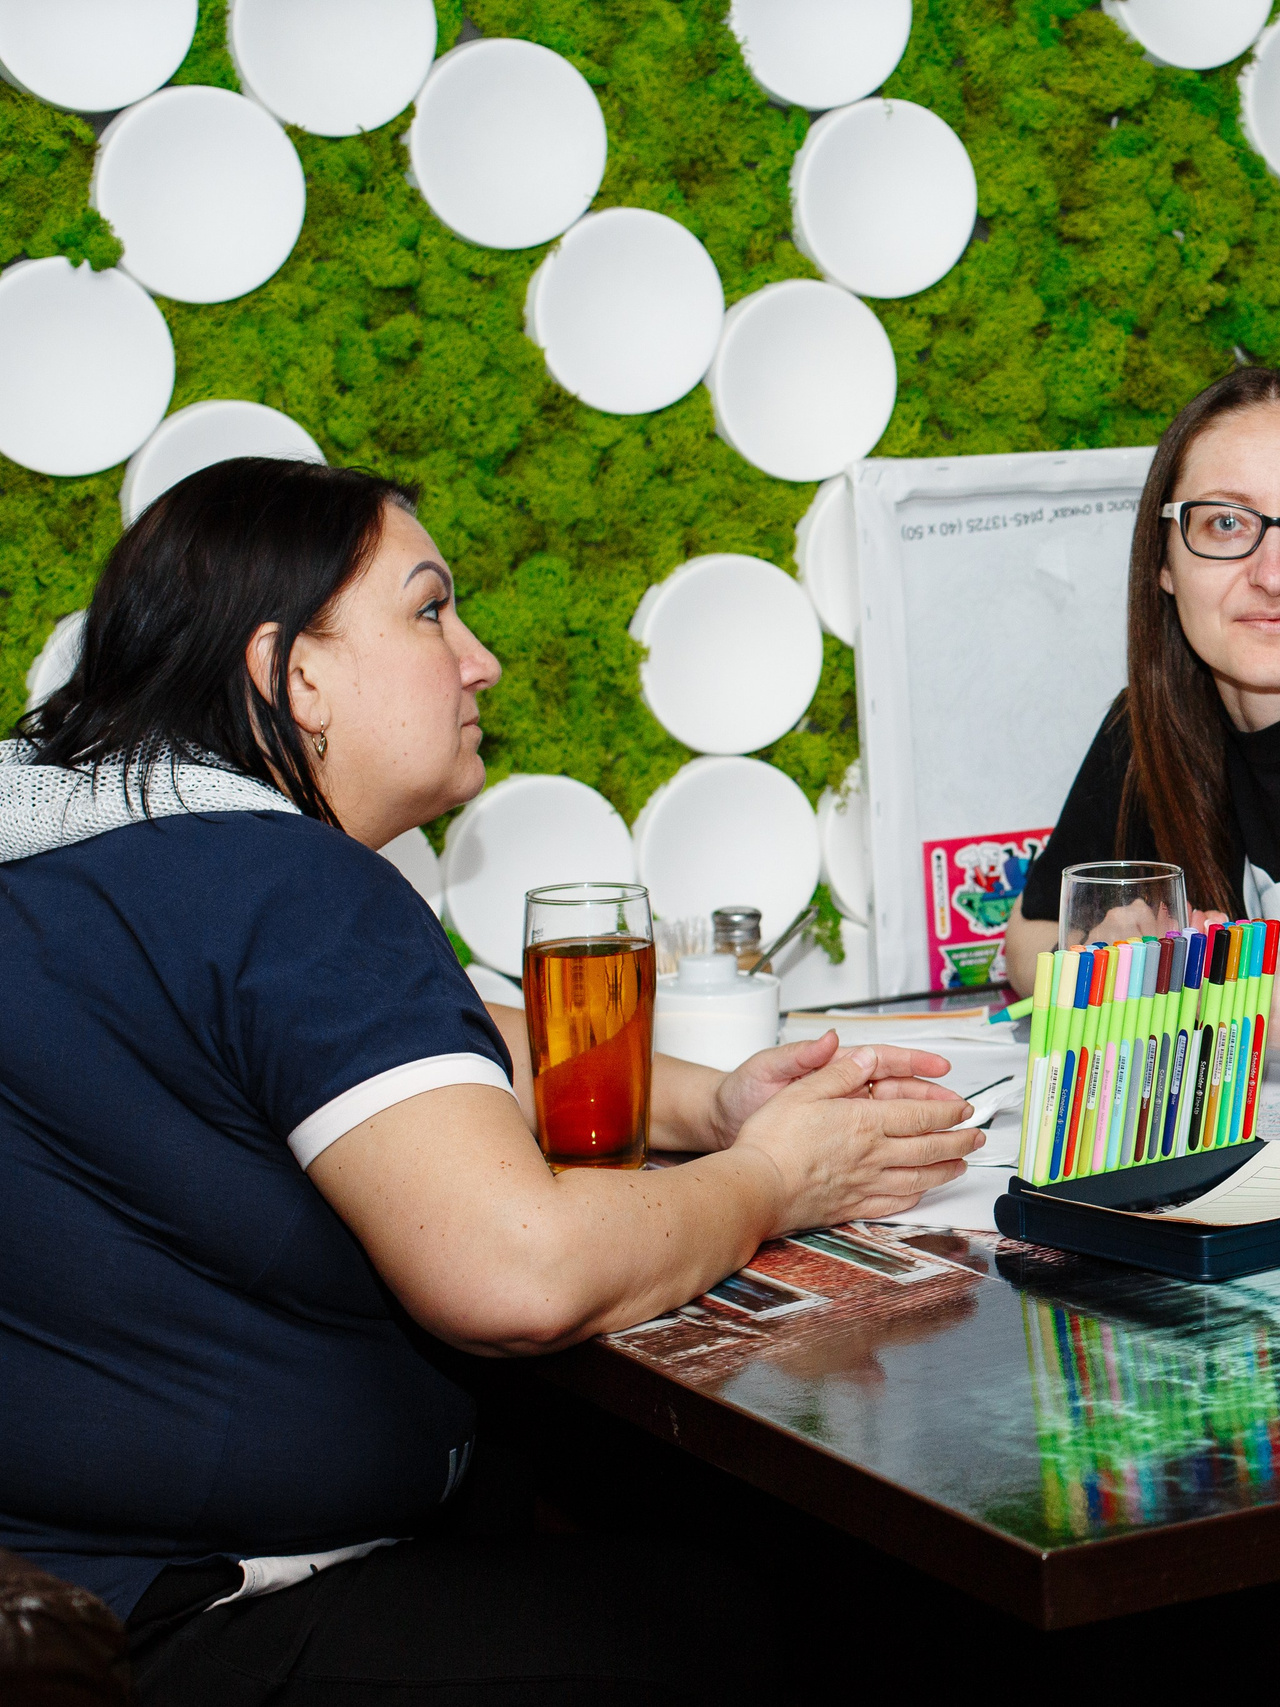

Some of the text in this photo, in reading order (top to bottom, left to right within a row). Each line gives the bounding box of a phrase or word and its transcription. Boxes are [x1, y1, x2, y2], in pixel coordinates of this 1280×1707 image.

[1156, 1069, 1165, 1097] Schneider
[1197, 1060, 1207, 1091] Schneider
[1058, 1088, 1069, 1118] Schneider
